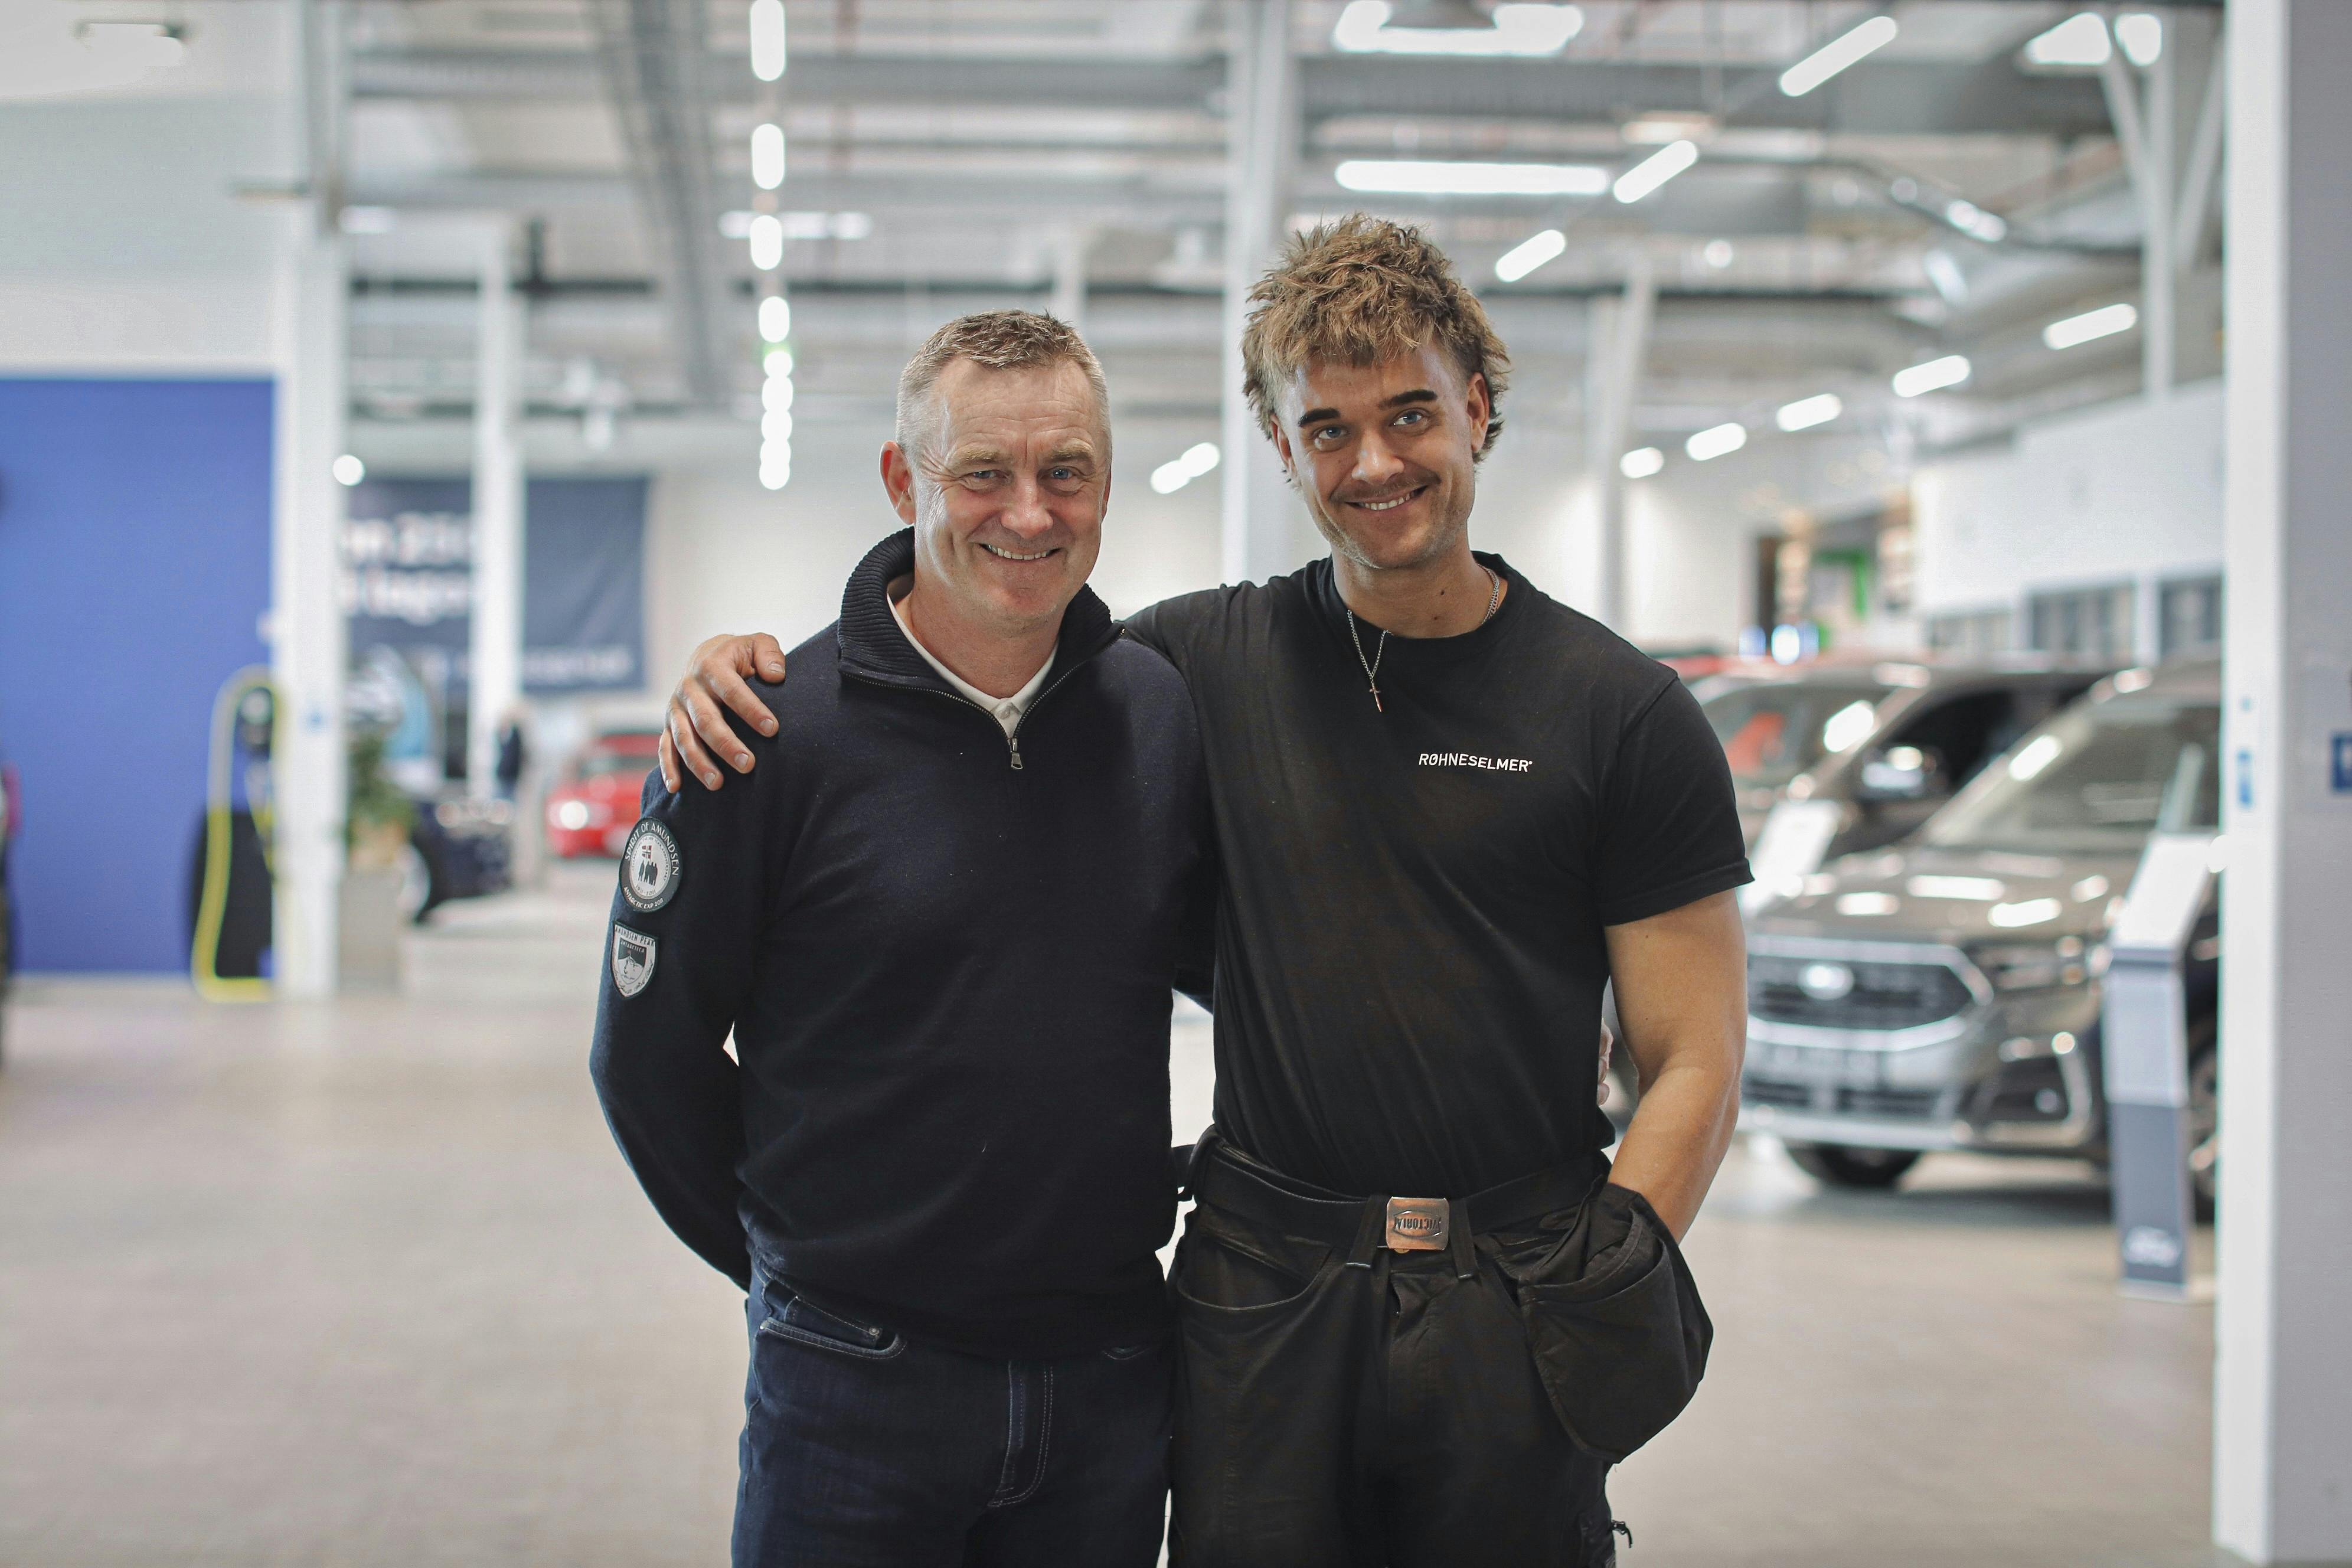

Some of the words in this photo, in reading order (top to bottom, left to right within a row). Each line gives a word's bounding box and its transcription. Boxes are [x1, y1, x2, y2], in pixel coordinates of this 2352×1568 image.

[1418, 753, 1530, 772] RØHNESELMER
[625, 828, 640, 861] SPIRIT
[641, 822, 649, 832] OF
[651, 822, 680, 876] AMUNDSEN
[623, 887, 643, 908] ANTARCTIC
